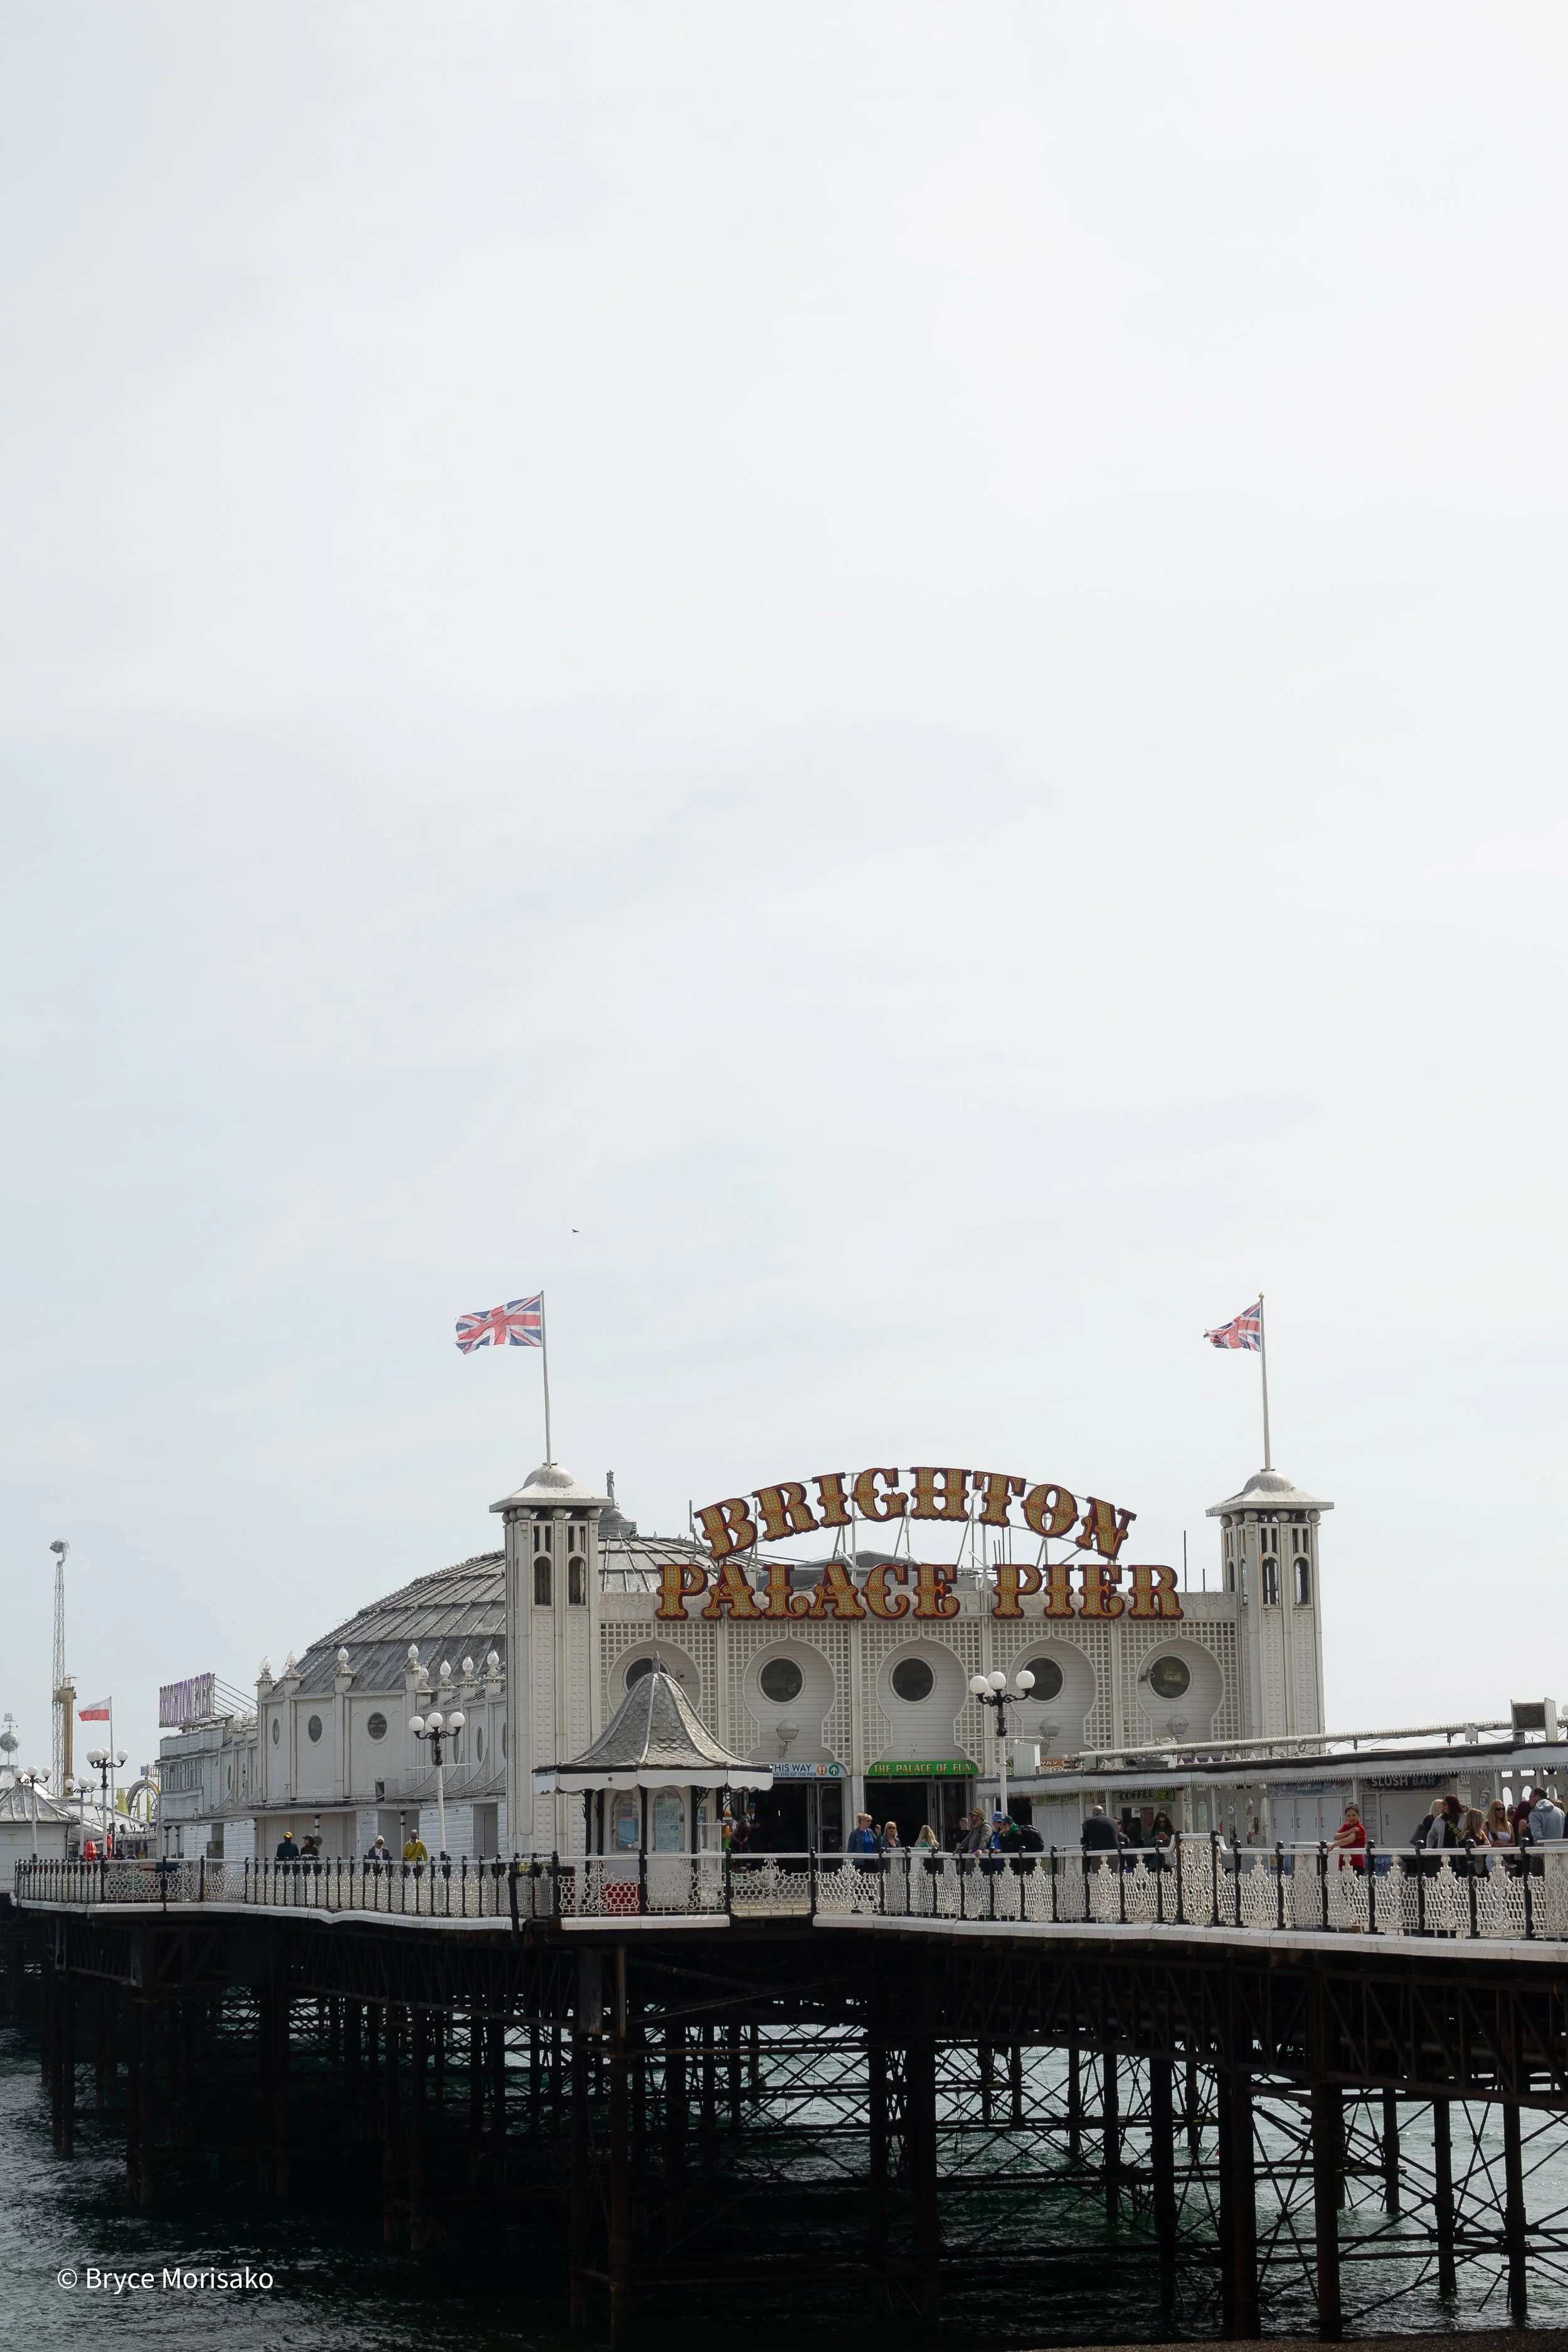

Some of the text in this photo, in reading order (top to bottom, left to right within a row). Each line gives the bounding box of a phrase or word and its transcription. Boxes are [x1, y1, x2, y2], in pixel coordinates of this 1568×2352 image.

[694, 1466, 1136, 1560] BRIGHTON
[655, 1563, 1184, 1621] PALACE PIER
[792, 1764, 812, 1772] WAY
[874, 1763, 972, 1773] THE PALACE OF FUN
[1372, 1776, 1435, 1787] SLUSH BAR
[1119, 1789, 1153, 1801] COFFEE
